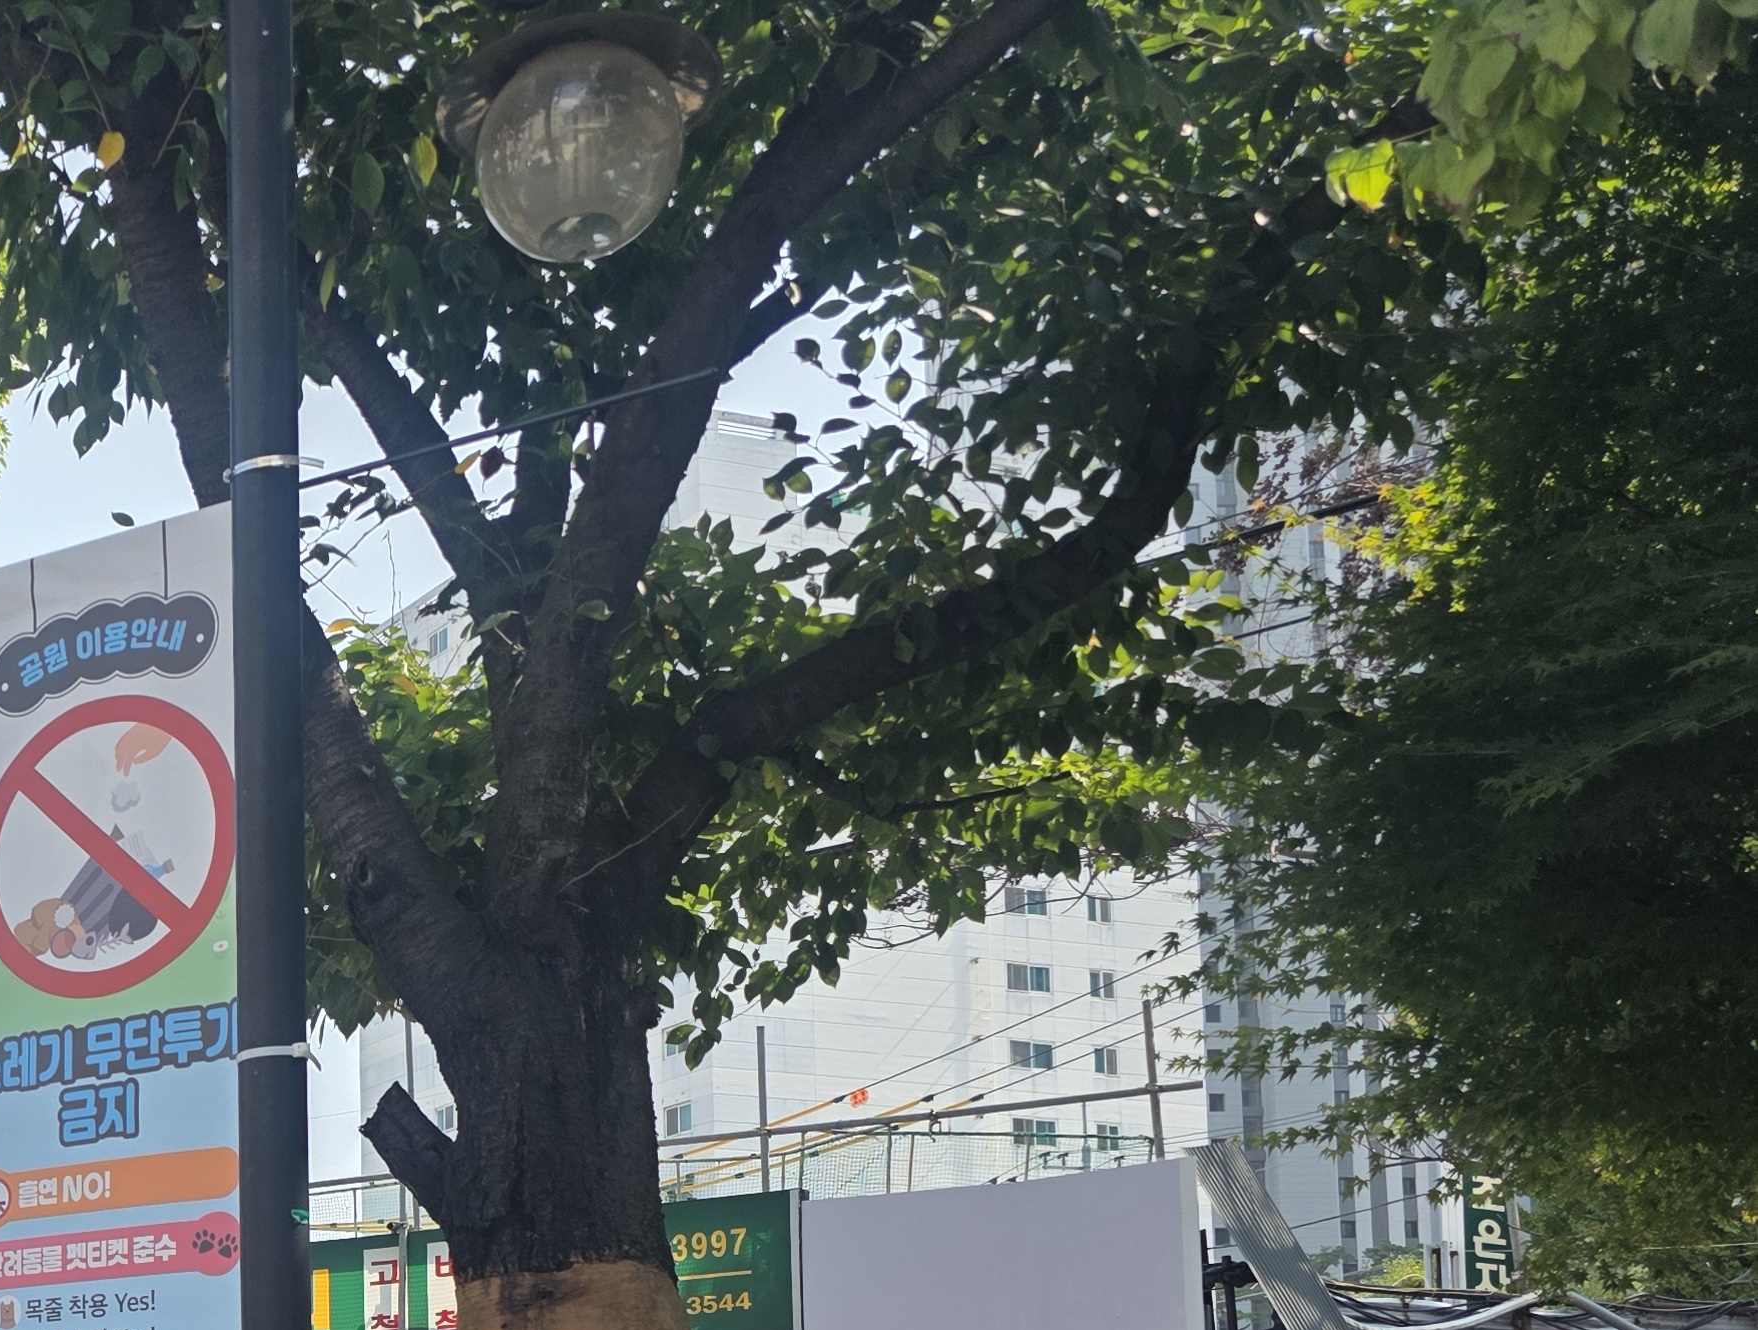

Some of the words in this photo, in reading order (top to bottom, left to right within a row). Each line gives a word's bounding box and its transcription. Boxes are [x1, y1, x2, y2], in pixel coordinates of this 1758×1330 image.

[17, 637, 69, 688] 공원
[75, 617, 187, 661] 이용안내
[85, 1000, 238, 1077] 무단투기
[60, 1080, 137, 1144] 금지
[18, 1177, 58, 1209] 흡연
[62, 1170, 111, 1203] NO!
[66, 1238, 129, 1270] 펫티켓
[132, 1233, 177, 1264] 준수
[671, 1227, 747, 1263] 3997
[24, 1298, 64, 1323] 목줄
[68, 1293, 109, 1319] 착용
[114, 1289, 156, 1313] Yes!
[685, 1291, 752, 1316] 3544
